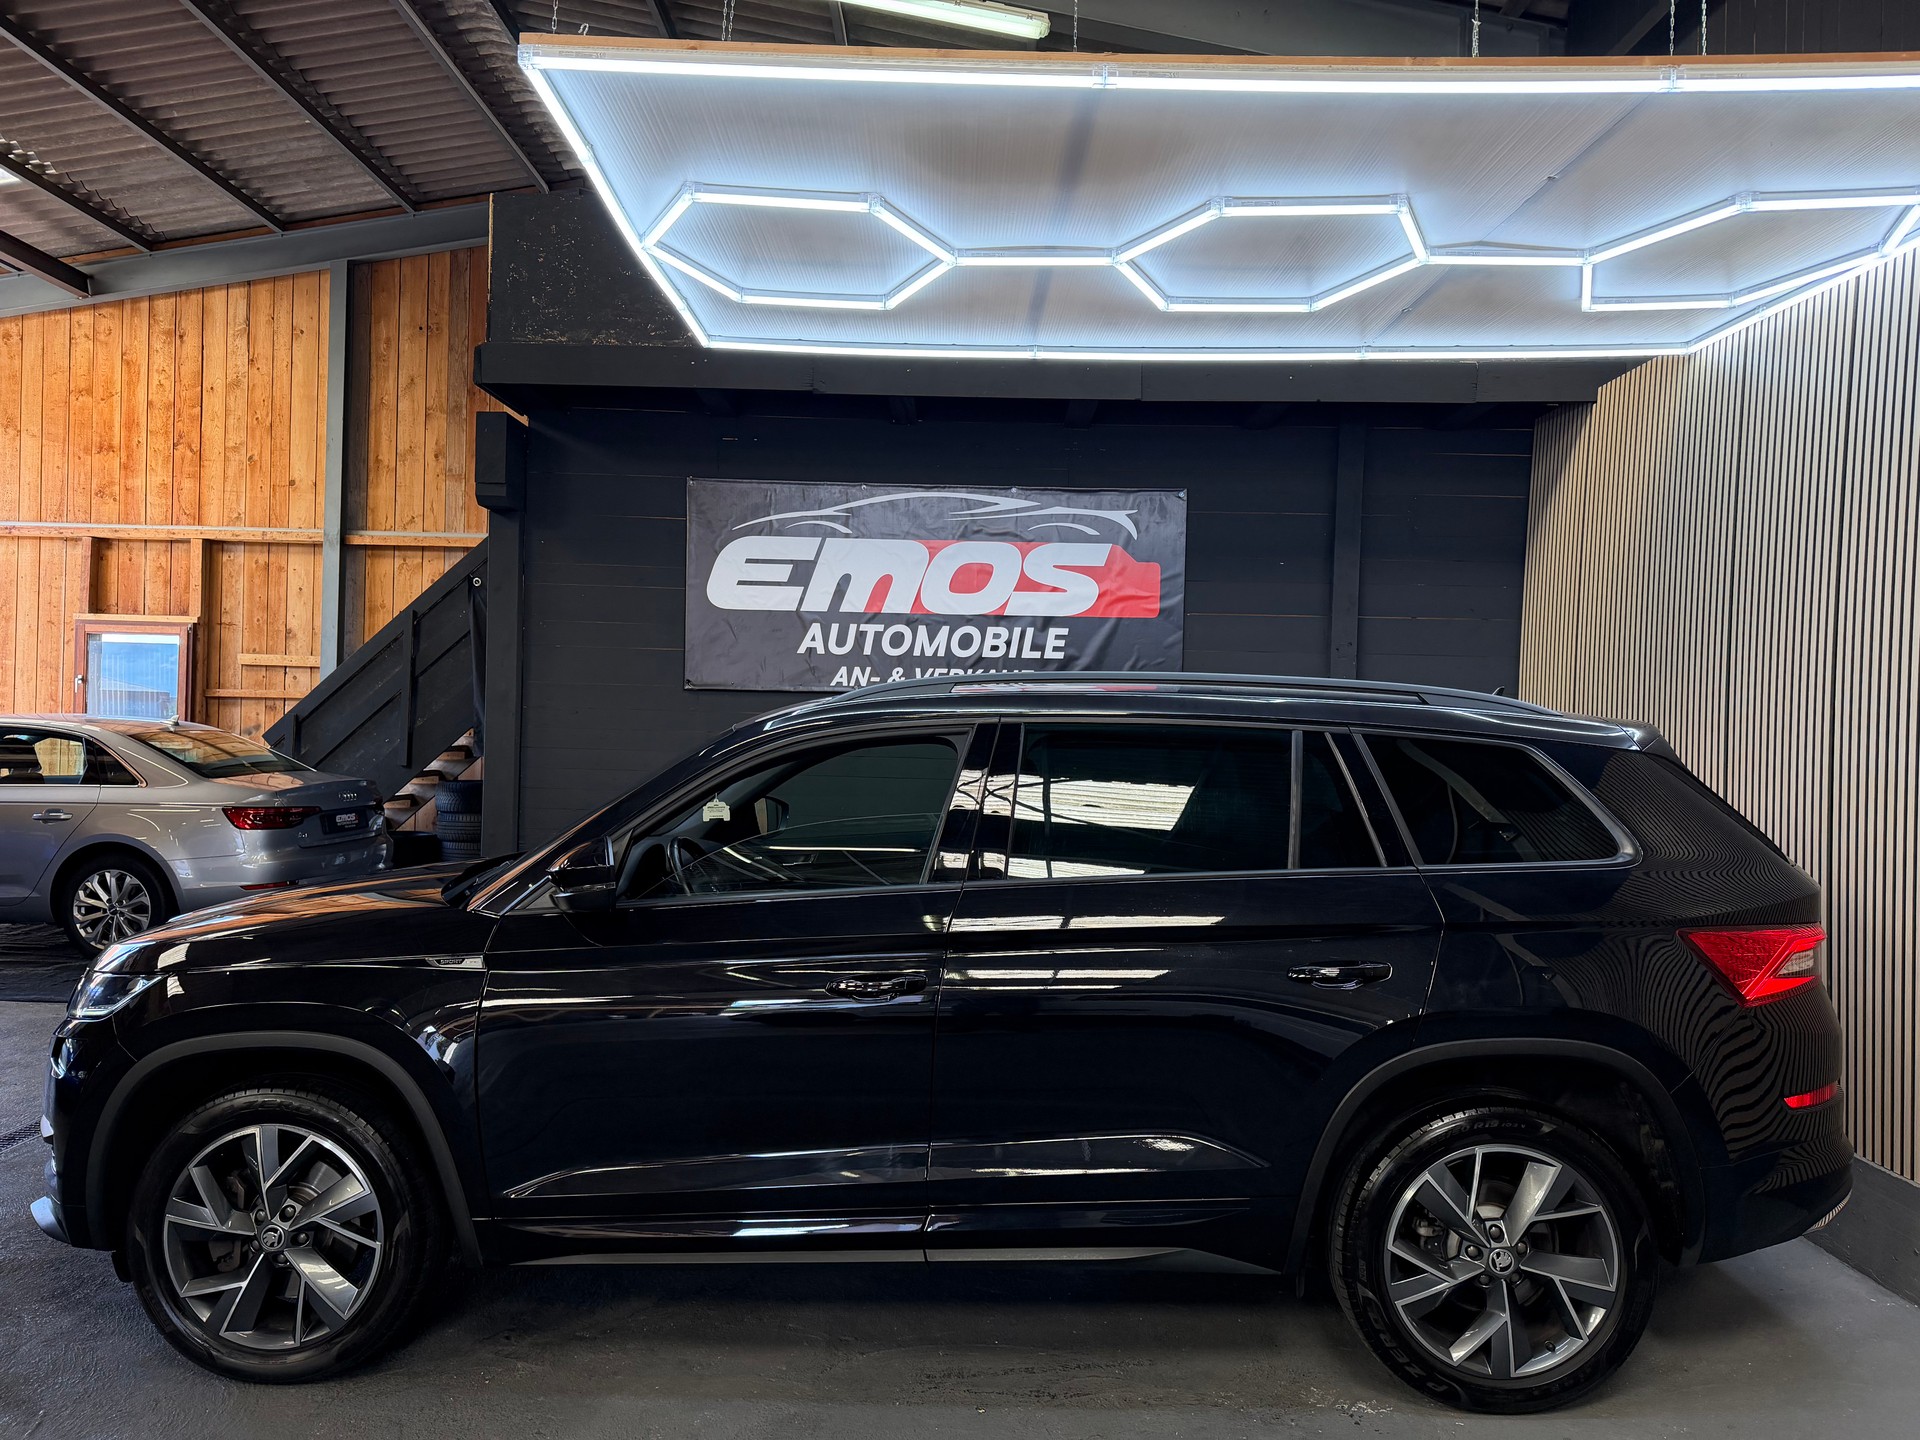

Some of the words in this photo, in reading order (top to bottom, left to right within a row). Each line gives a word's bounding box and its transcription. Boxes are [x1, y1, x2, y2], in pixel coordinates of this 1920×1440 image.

[707, 536, 1113, 617] EMOS
[797, 623, 1069, 660] AUTOMOBILE
[829, 666, 881, 687] AN-
[886, 667, 906, 683] &
